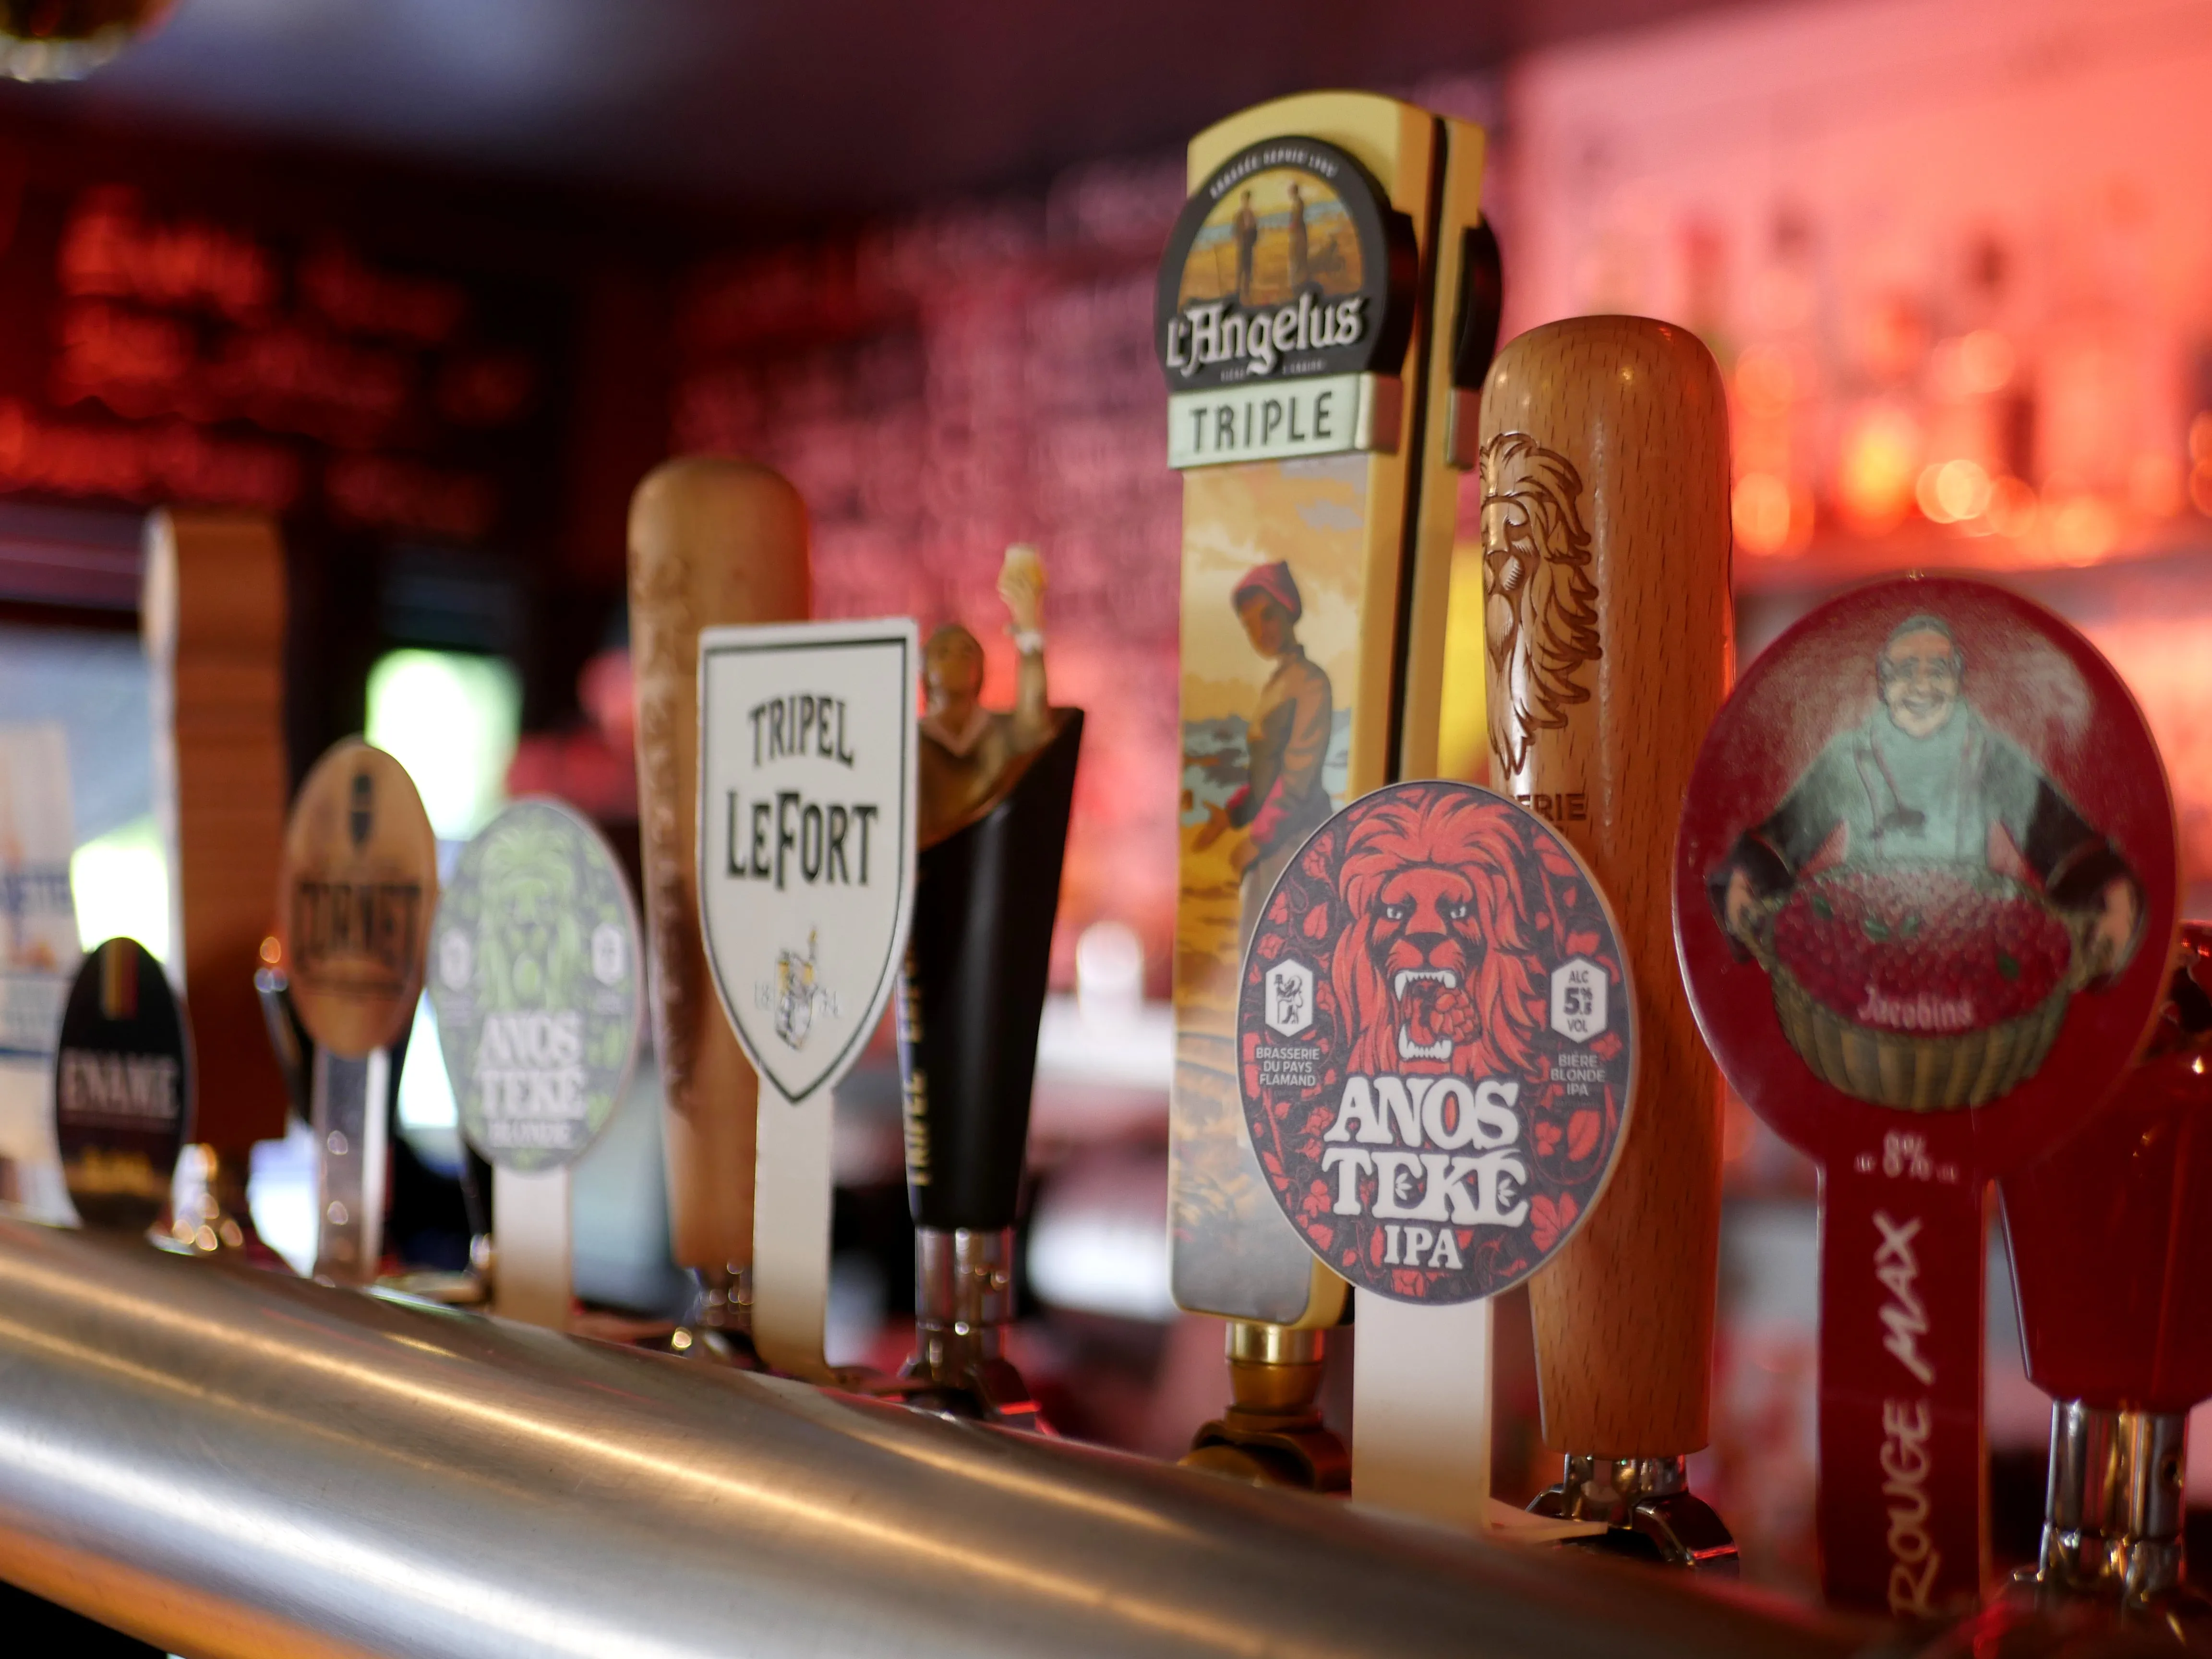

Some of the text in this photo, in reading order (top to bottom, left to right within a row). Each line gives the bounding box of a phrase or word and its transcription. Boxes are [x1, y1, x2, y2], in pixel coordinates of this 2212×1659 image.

[1189, 390, 1333, 454] TRIPLE
[749, 694, 854, 769] TRIPEL
[1569, 970, 1588, 983] ALC
[1568, 1019, 1588, 1033] VOL
[1256, 1047, 1320, 1060] BRASSERIE
[1263, 1060, 1312, 1073] DU PAYS
[1260, 1073, 1316, 1087] FLAMAND
[1550, 1068, 1606, 1083] BLONDE
[1567, 1082, 1589, 1097] IPA
[1323, 1076, 1520, 1150] ANOS
[1384, 1225, 1464, 1270] IPA
[1871, 1209, 1942, 1619] ROUGE MAX
